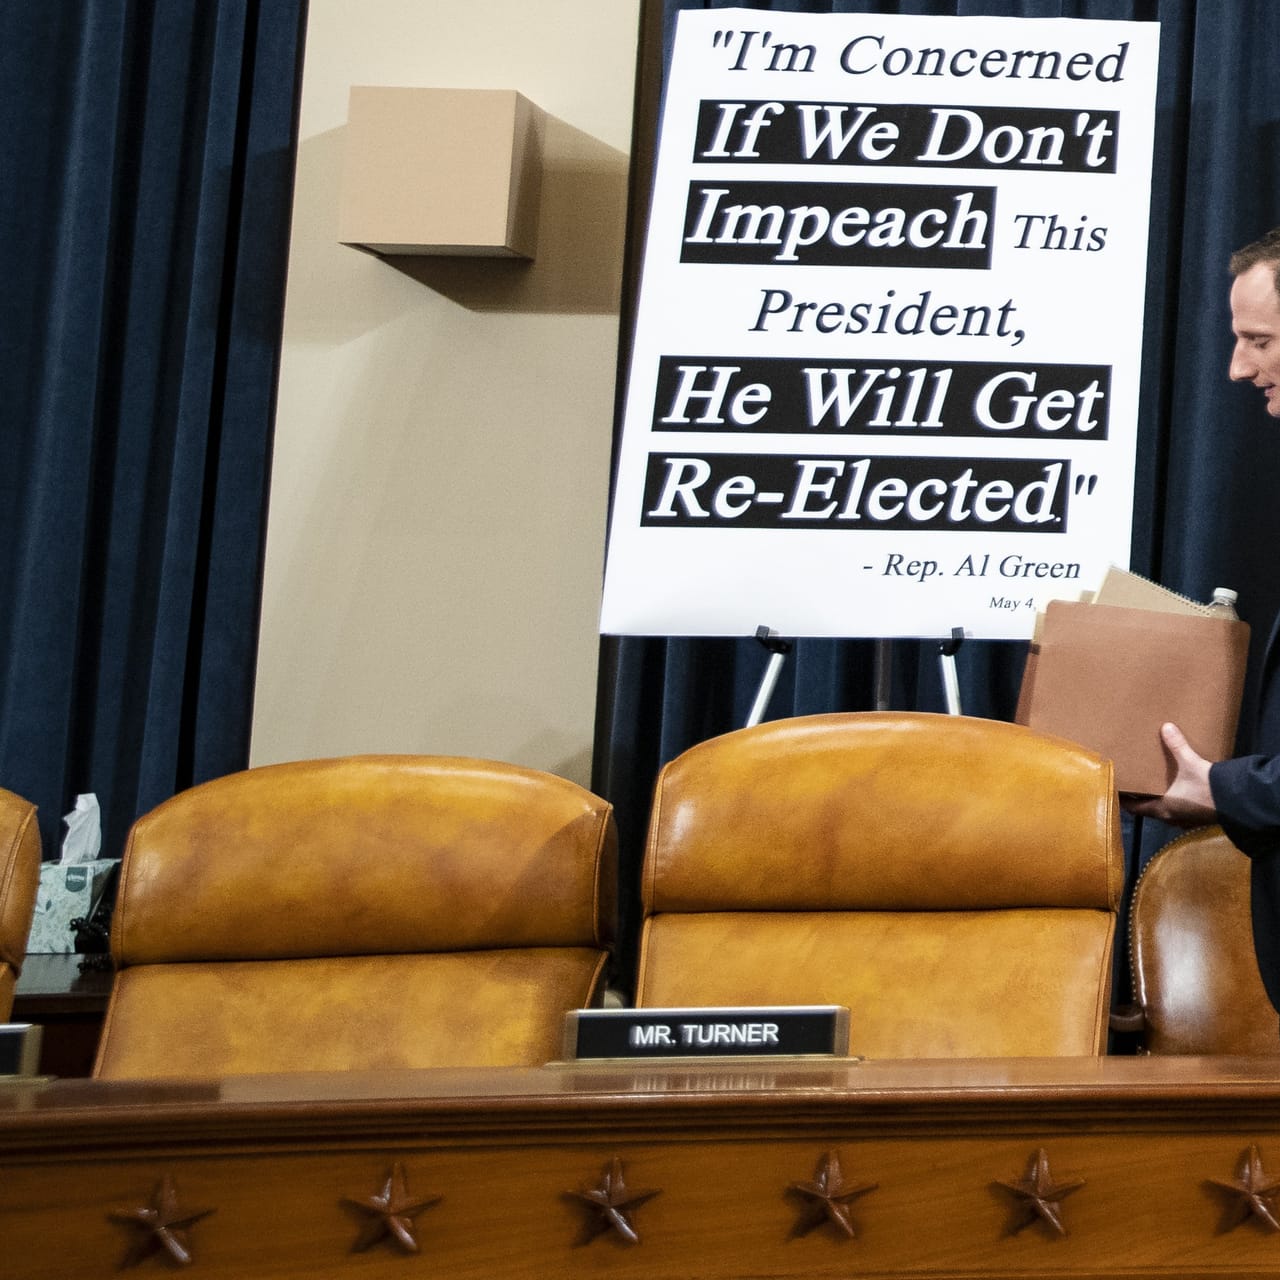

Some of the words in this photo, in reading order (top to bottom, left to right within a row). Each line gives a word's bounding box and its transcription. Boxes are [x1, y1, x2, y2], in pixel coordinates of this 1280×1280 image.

[712, 30, 817, 73] "I'm
[839, 35, 1130, 83] Concerned
[701, 102, 786, 158] If
[796, 103, 901, 161] We
[916, 108, 1115, 167] Don't
[684, 188, 989, 262] Impeach
[1013, 214, 1108, 252] This
[747, 289, 1025, 347] President,
[661, 365, 773, 425] He
[803, 367, 953, 428] Will
[975, 371, 1105, 432] Get
[882, 553, 944, 583] Rep.
[953, 554, 990, 577] Al
[999, 555, 1081, 579] Green
[989, 596, 1021, 610] May
[634, 1025, 676, 1045] MR.
[682, 1023, 779, 1044] TURNER
